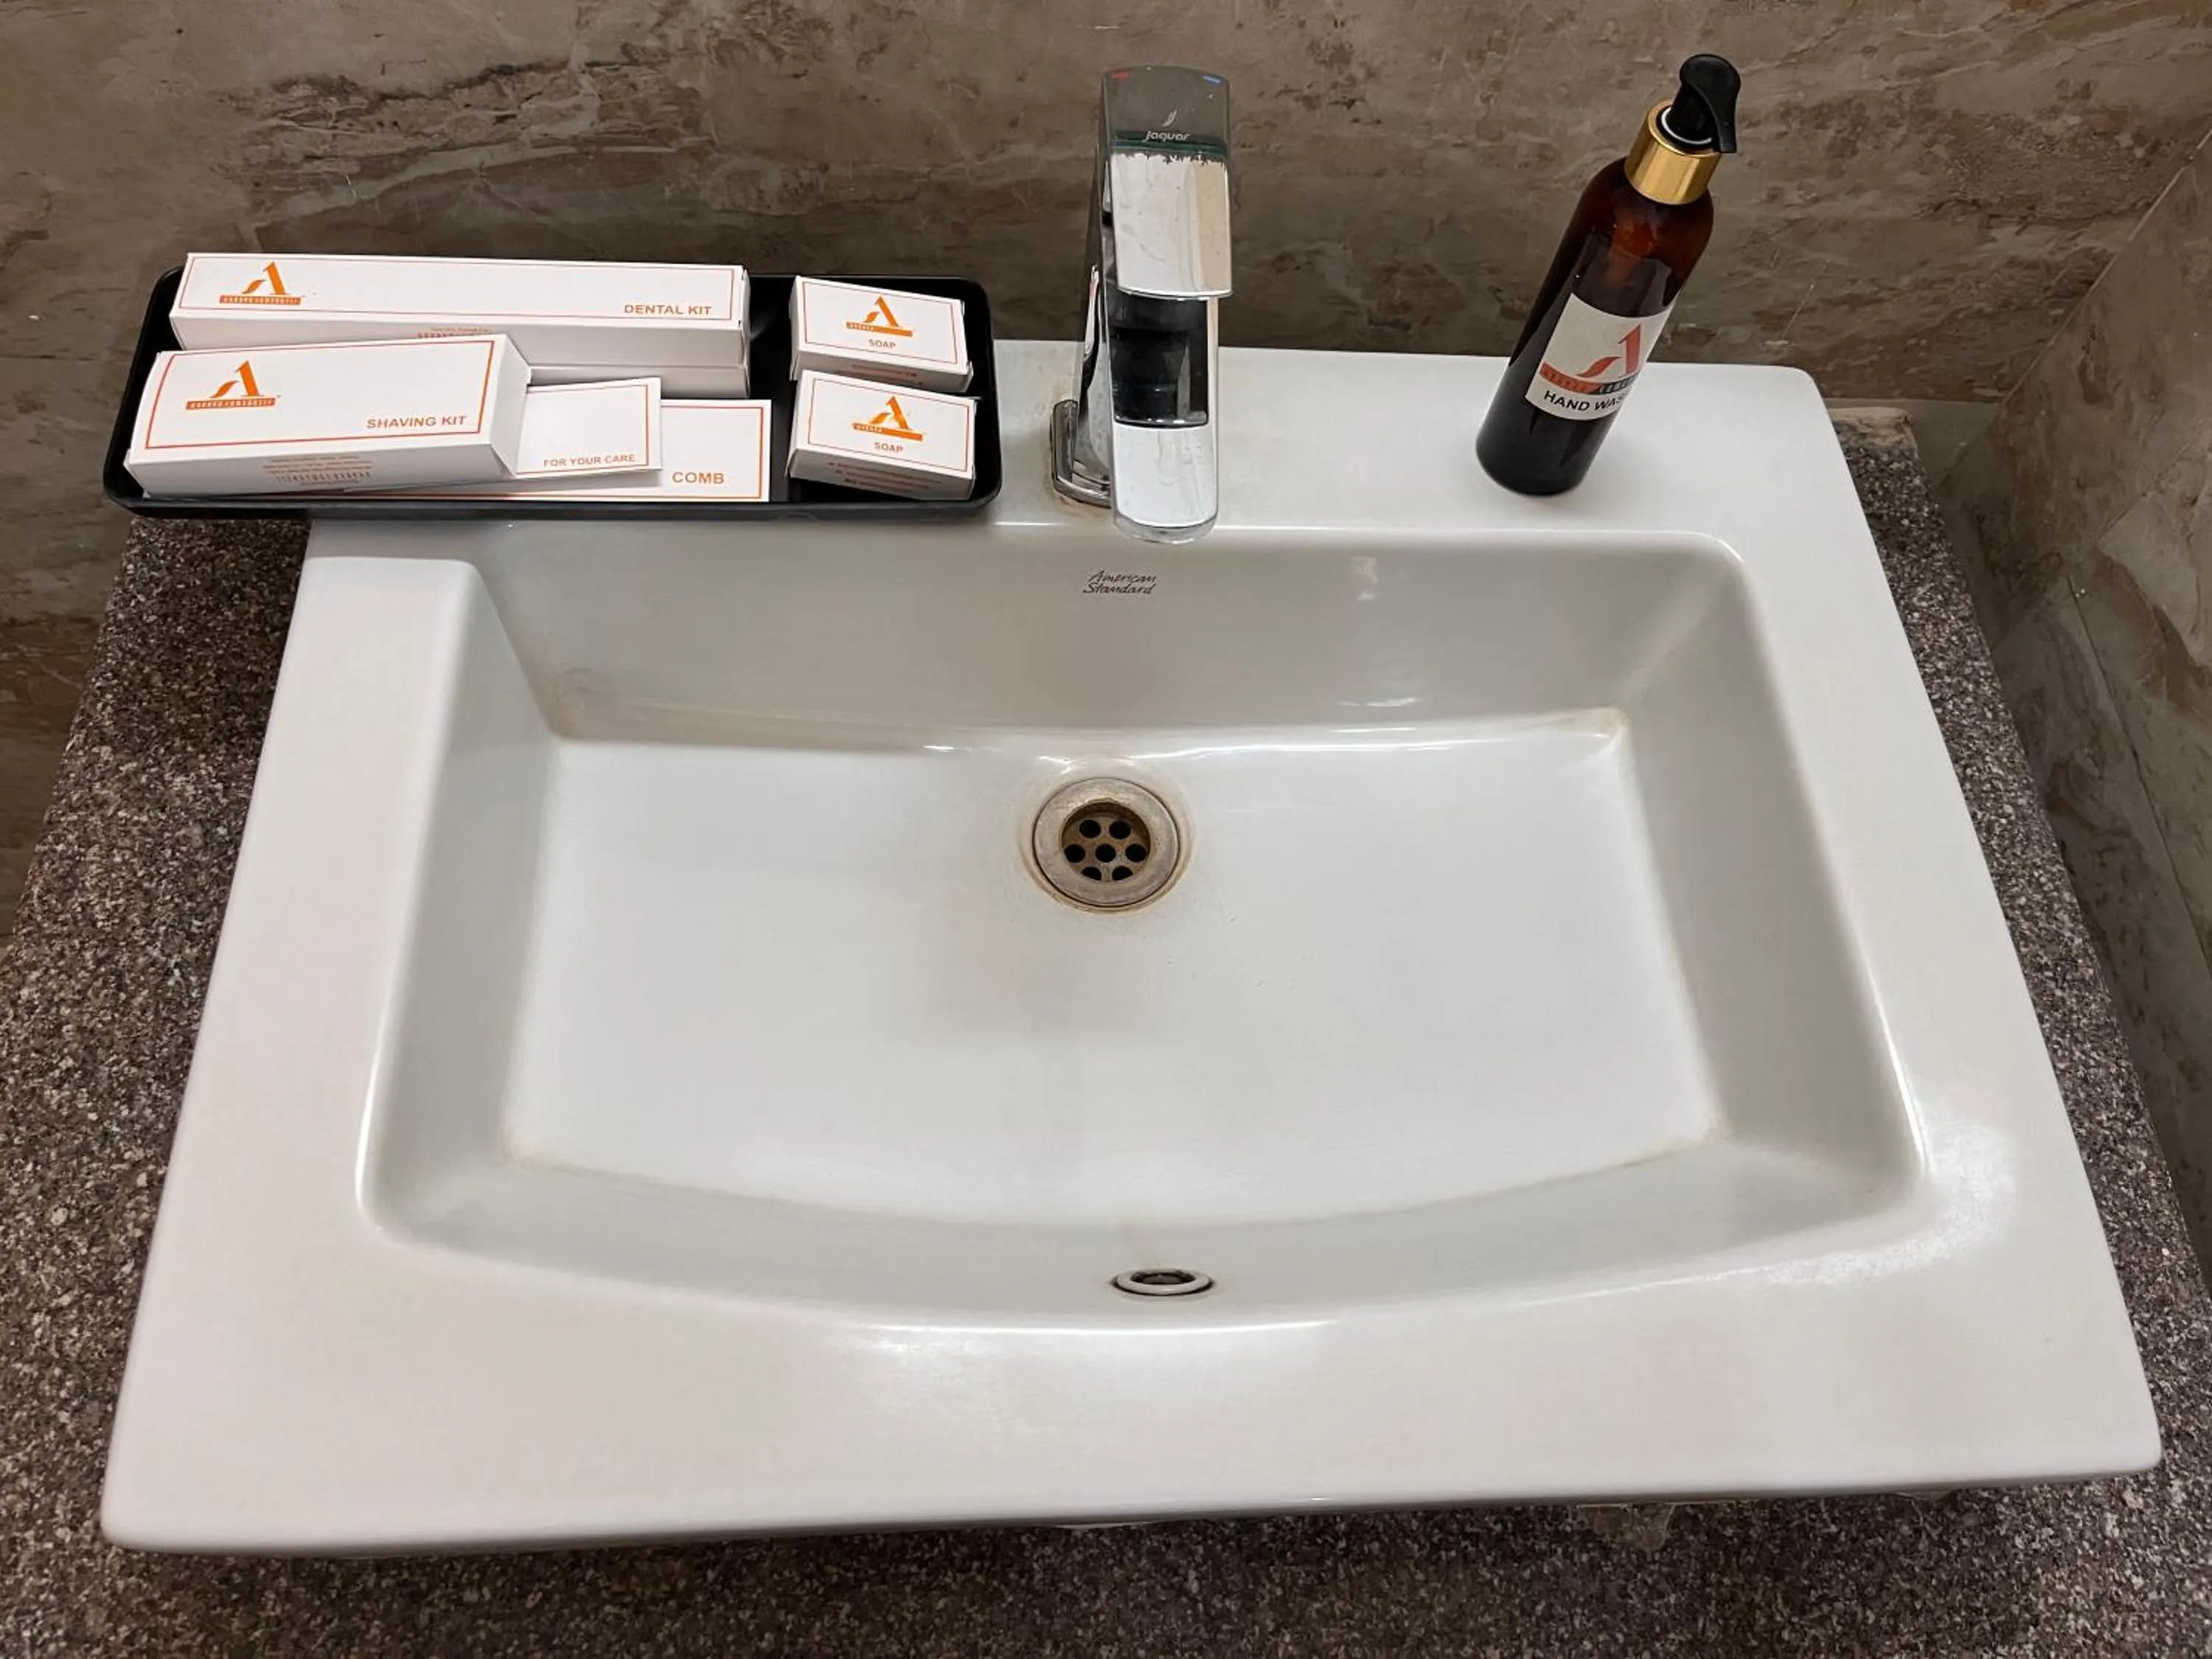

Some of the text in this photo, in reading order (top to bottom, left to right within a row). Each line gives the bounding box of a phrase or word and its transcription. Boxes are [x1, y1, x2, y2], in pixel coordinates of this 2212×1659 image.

[624, 304, 712, 316] DENTAL KIT
[868, 338, 897, 349] SOAP
[1543, 390, 1590, 411] HAND
[366, 415, 467, 428] SHAVING KIT
[874, 442, 904, 453] SOAP
[543, 454, 636, 467] FOR YOUR CARE
[672, 471, 725, 484] COMB
[1088, 569, 1157, 582] American
[1082, 582, 1157, 594] Standard
